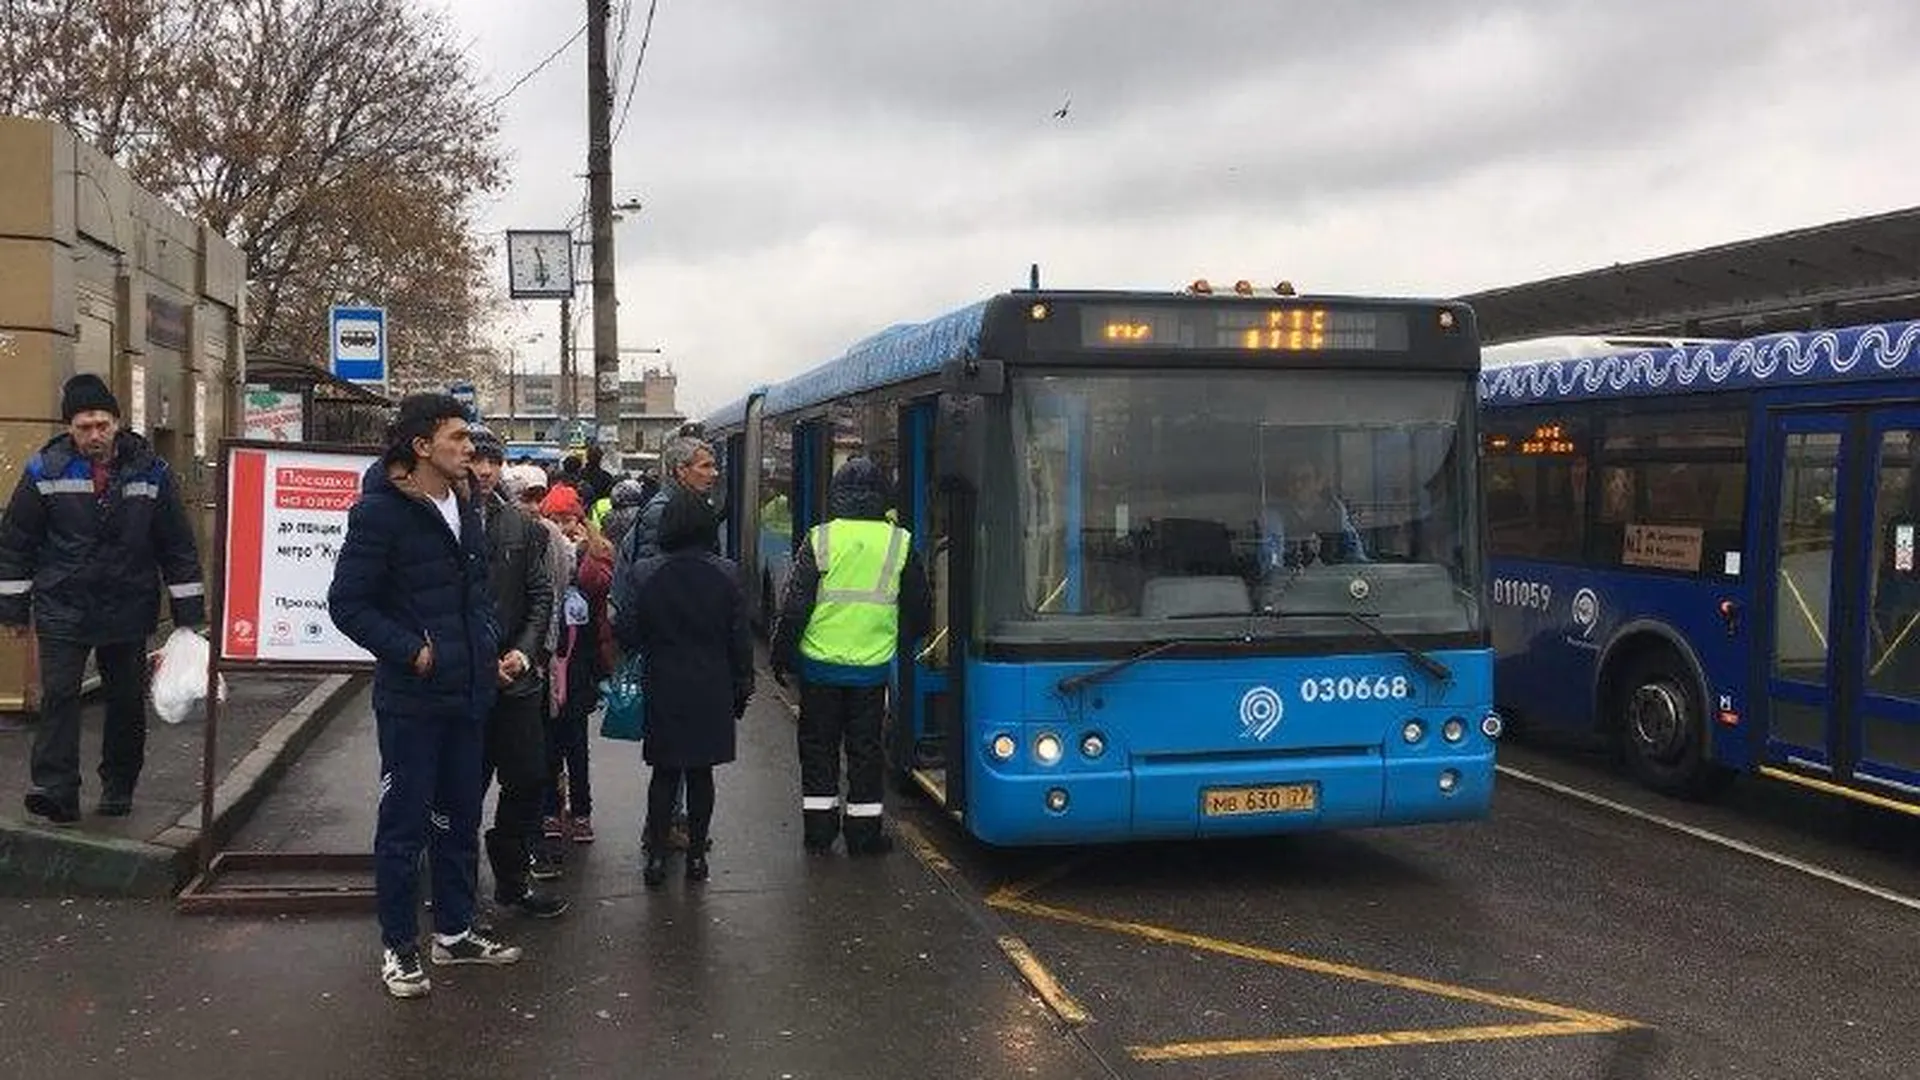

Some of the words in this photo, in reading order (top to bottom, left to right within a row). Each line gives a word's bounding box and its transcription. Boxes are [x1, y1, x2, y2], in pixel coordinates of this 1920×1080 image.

[281, 469, 354, 488] Посадка
[280, 494, 301, 507] на
[278, 522, 293, 534] до
[296, 522, 342, 536] станции
[278, 546, 313, 561] метро
[1494, 578, 1552, 612] 011059
[1300, 675, 1407, 702] 030668
[1246, 791, 1280, 810] 630
